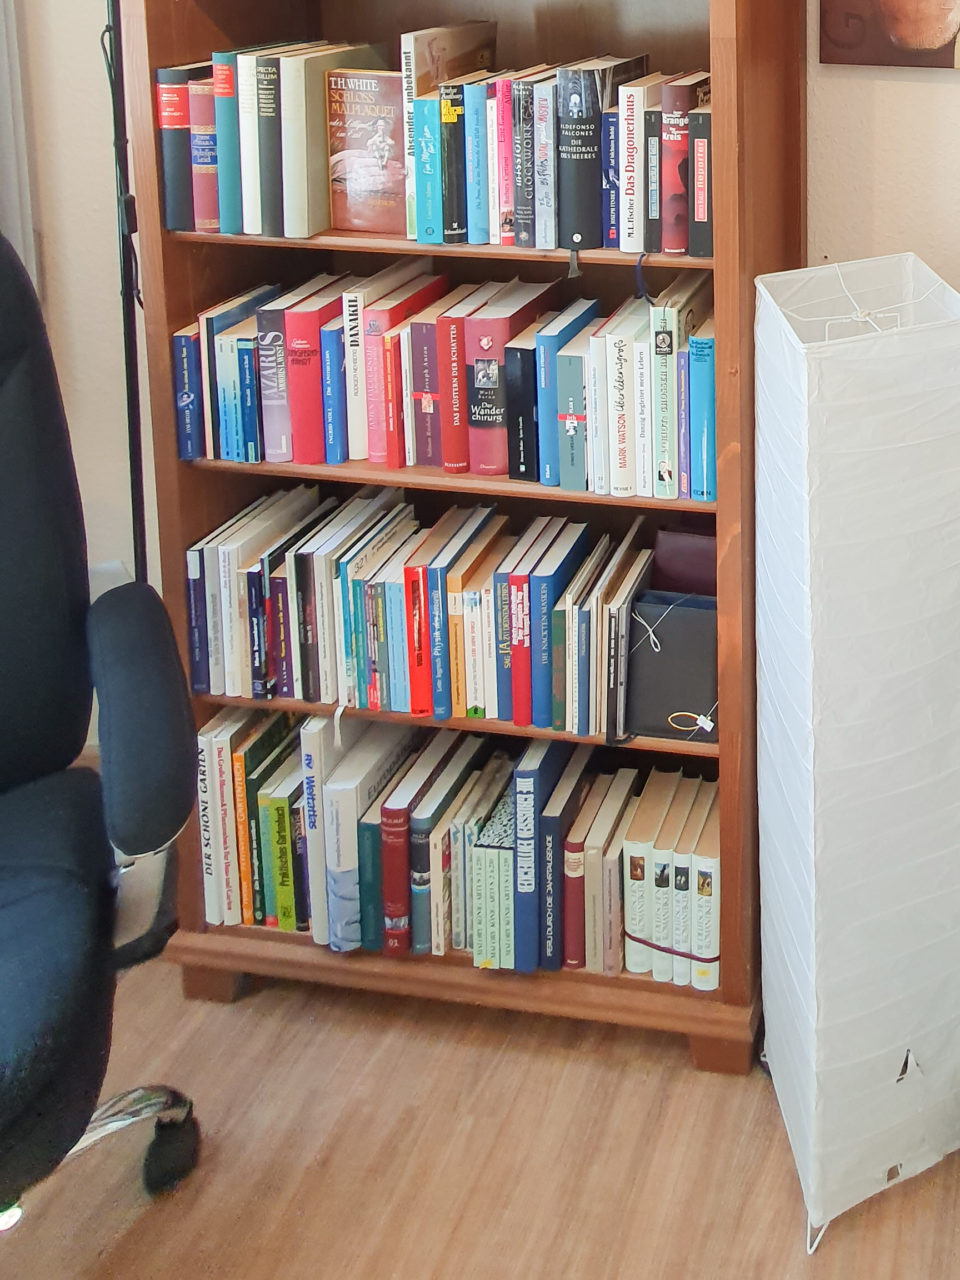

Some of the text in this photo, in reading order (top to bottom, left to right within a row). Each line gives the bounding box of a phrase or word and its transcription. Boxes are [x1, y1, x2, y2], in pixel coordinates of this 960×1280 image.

[331, 90, 375, 103] SCHLOSS
[403, 51, 413, 104] unbekannt
[523, 122, 534, 200] CLOCKWORK
[623, 93, 638, 196] Das Dragonerhaus
[348, 296, 360, 347] DANAKIL
[257, 331, 287, 406] LAZARUS
[449, 324, 460, 425] DAS FLÜSTERN DER SCHATTEN
[637, 351, 645, 370] Leben
[470, 405, 505, 416] Wander
[471, 413, 503, 423] chirurg
[481, 401, 493, 409] Der
[616, 413, 627, 469] MARK WATSON
[639, 418, 648, 439] Danzig
[540, 583, 548, 614] MASKEN
[498, 641, 512, 655] JA
[197, 748, 208, 793] GARTEN
[304, 754, 318, 830] RV Weltatlas
[204, 852, 213, 876] DER
[545, 834, 553, 895] JAHRTAUSENDE
[545, 909, 553, 936] DURCH
